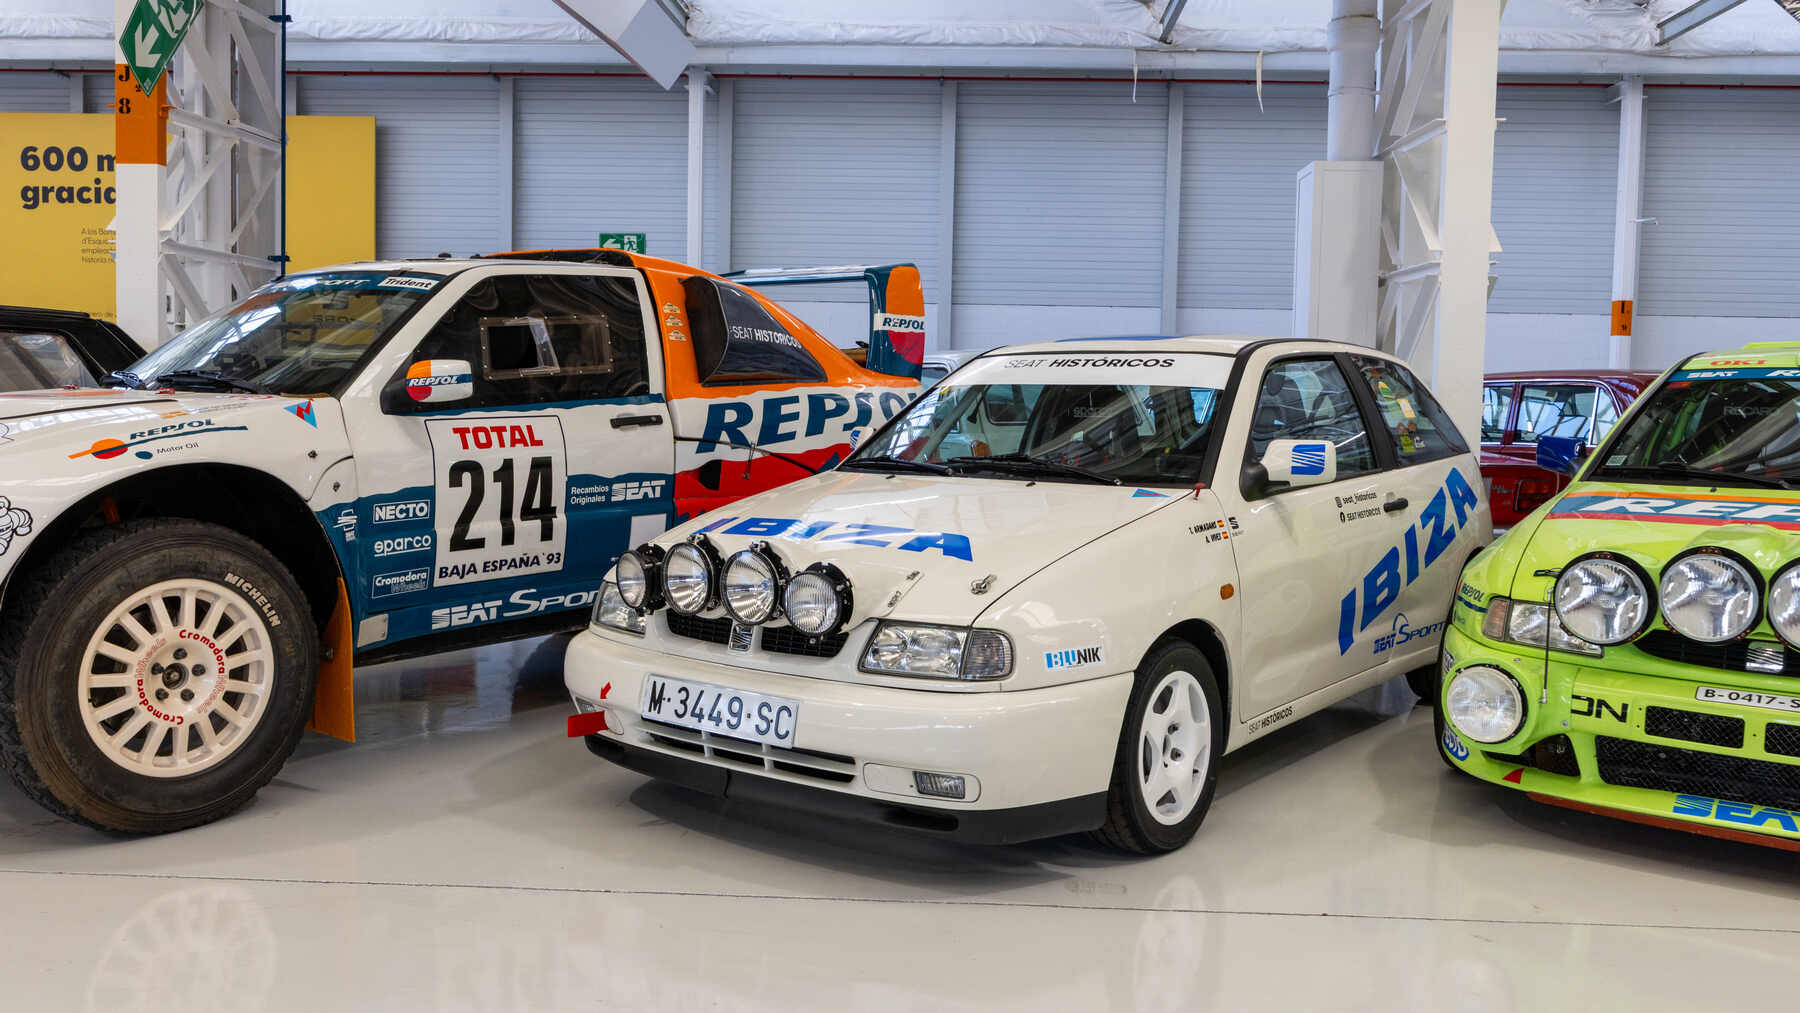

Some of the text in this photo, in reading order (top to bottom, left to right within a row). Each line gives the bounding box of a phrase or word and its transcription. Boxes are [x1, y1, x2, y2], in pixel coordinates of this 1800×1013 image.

[20, 146, 89, 172] 600
[385, 278, 433, 289] Trident
[733, 325, 753, 341] SEAT
[882, 317, 926, 330] REPSOL
[1004, 357, 1176, 369] SEAT HISTÓRICOS
[408, 375, 459, 388] REPSOL
[1687, 371, 1740, 379] SEAT
[130, 418, 216, 440] REPSOL
[695, 391, 918, 455] REPSO
[157, 442, 199, 454] Motor Oil
[452, 424, 544, 450] TOTAL
[570, 479, 666, 501] Recambios SEAT
[570, 494, 606, 505] Originales
[375, 502, 428, 521] NECTO
[449, 455, 558, 553] 214
[691, 516, 974, 562] IBIZA
[438, 563, 478, 579] BAJA
[482, 552, 541, 573] ESPAÑA
[1337, 467, 1478, 656] IBIZA
[375, 571, 428, 586] Cromodora
[224, 572, 282, 628] MICHELIN
[432, 599, 503, 630] SEAT
[1396, 621, 1446, 645] SPORT
[179, 629, 225, 674] Cromodora
[1046, 648, 1103, 669] BLUNIK
[136, 679, 185, 726] Cromodora
[1672, 793, 1800, 832] SEA
